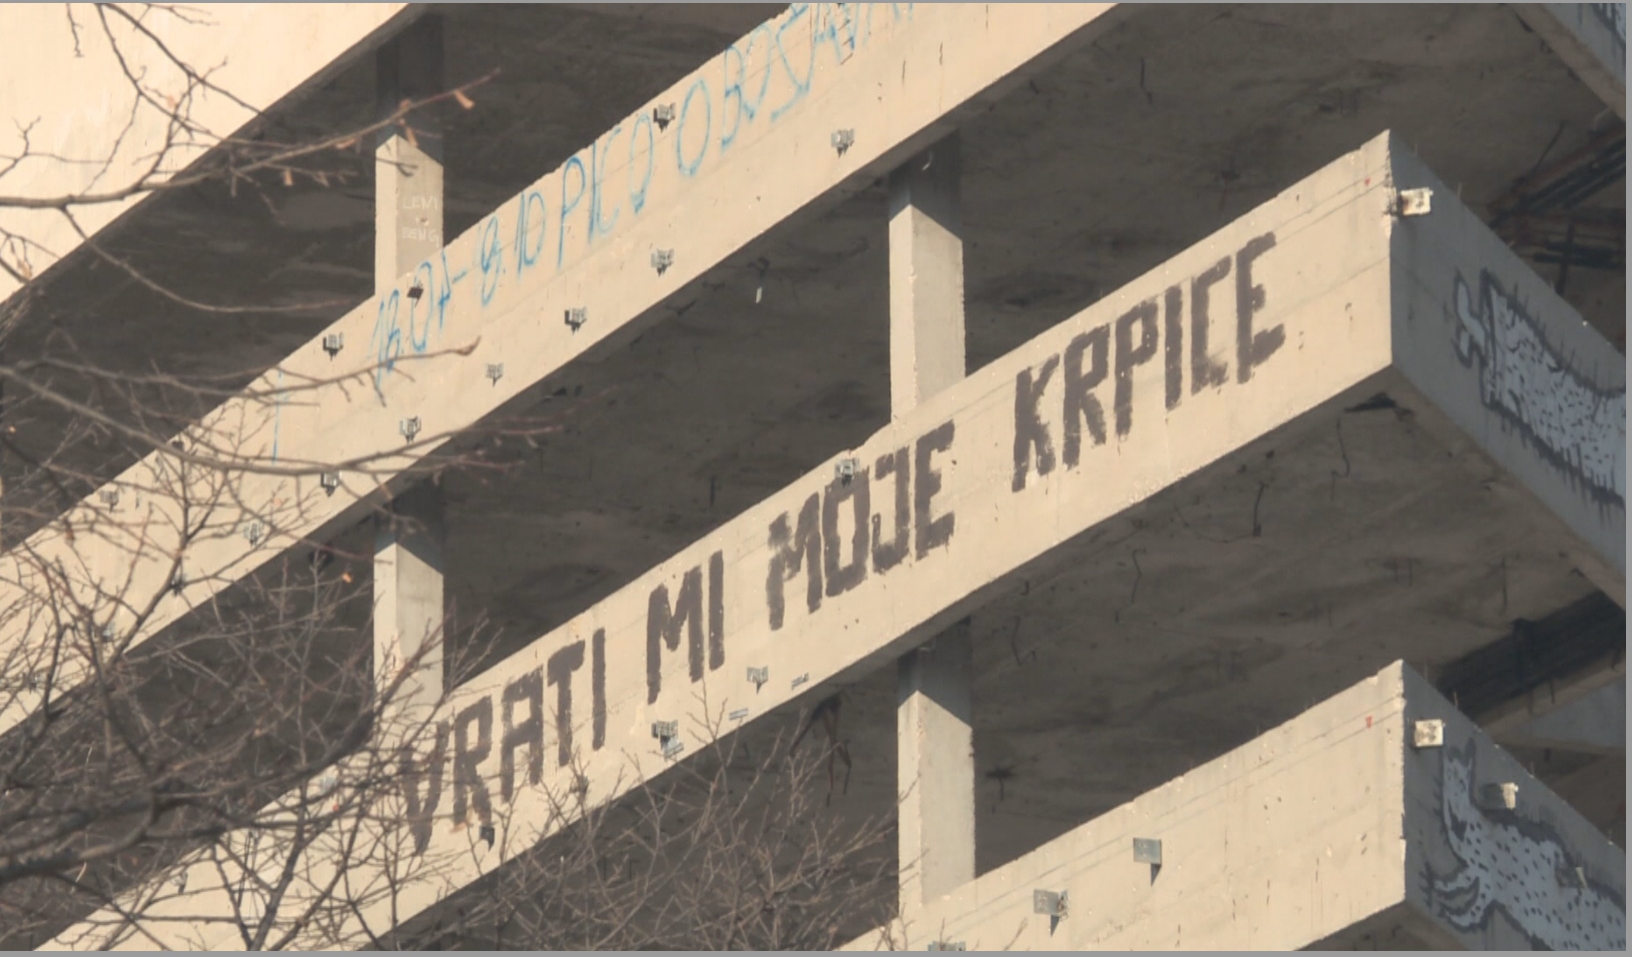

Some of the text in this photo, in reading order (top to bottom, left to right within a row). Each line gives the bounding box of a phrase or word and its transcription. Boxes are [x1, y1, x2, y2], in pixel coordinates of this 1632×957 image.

[398, 232, 1287, 857] VRATI MI MOJE KRPICE
